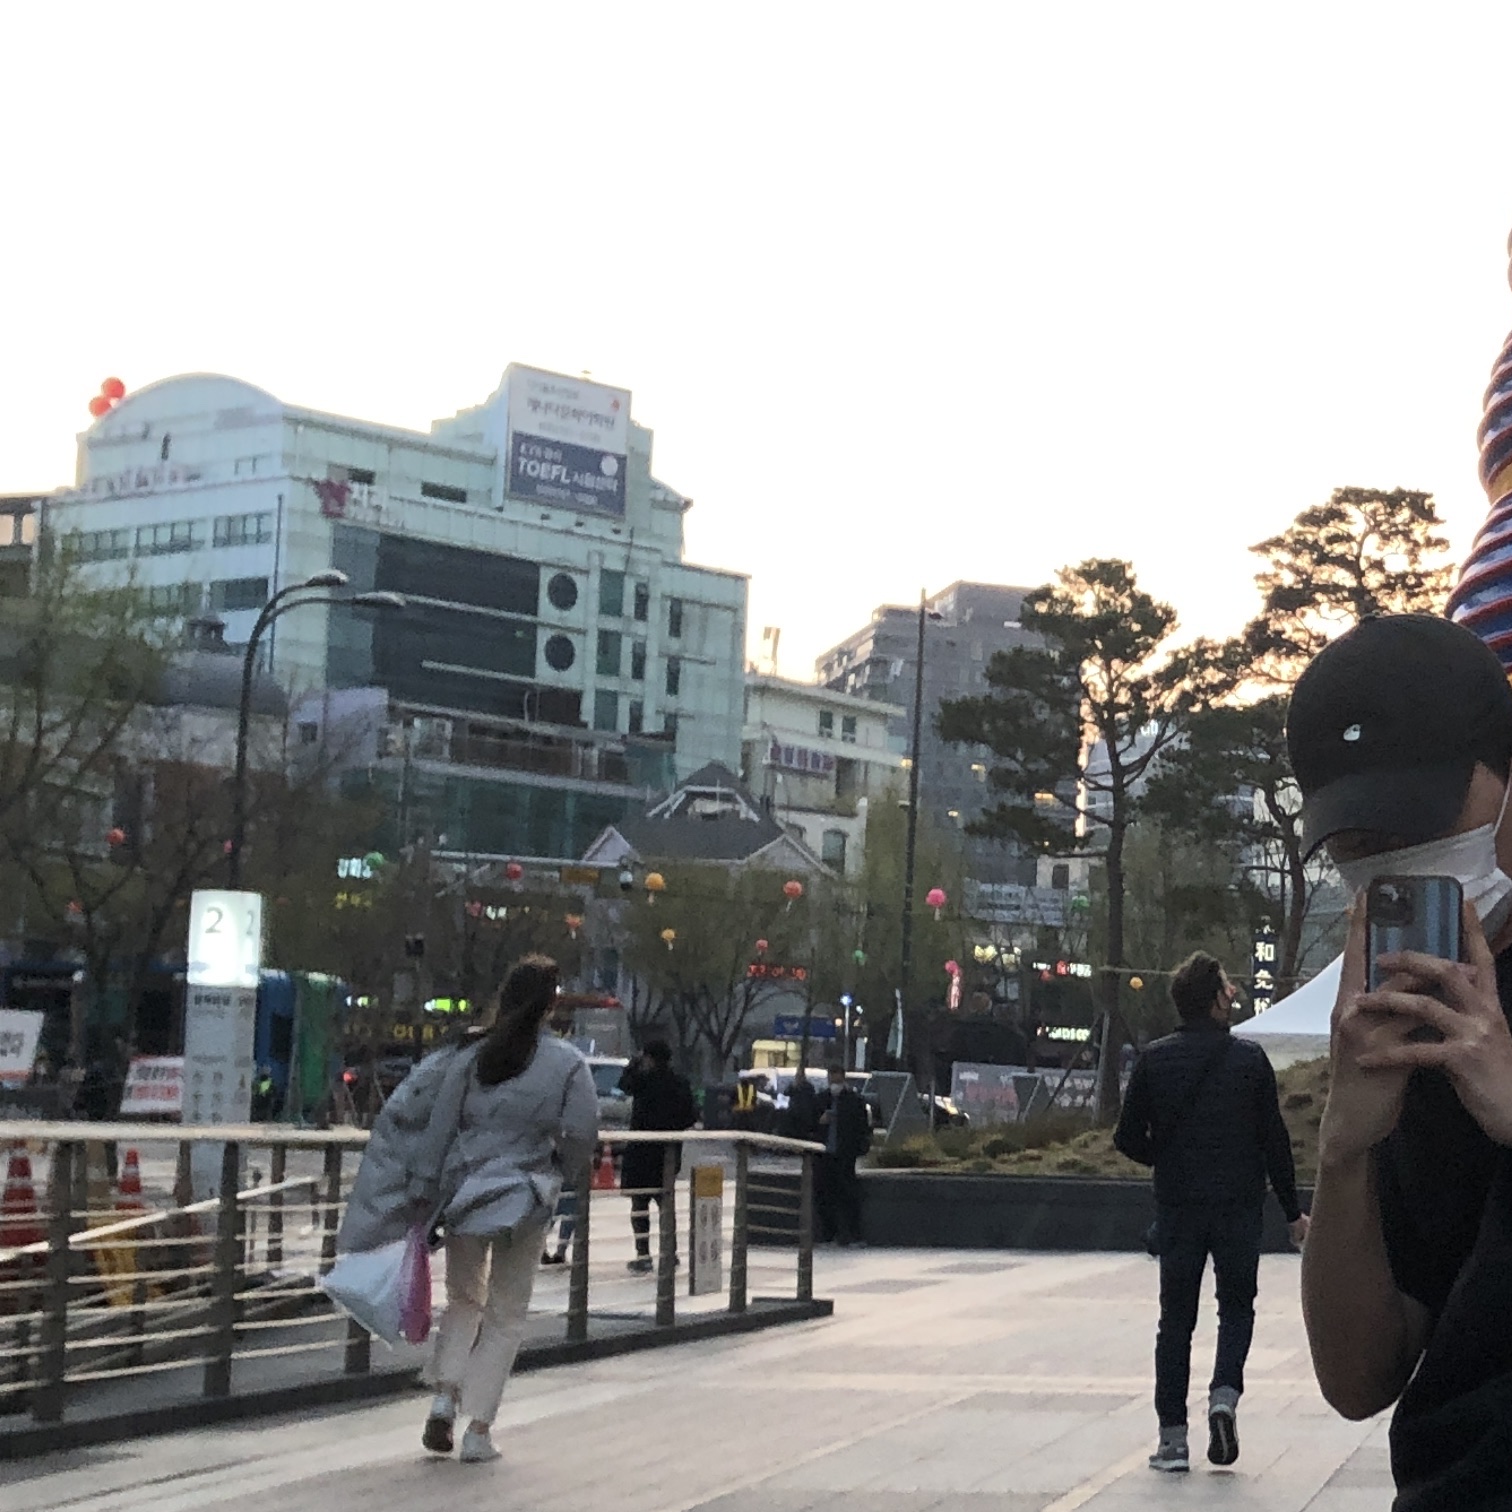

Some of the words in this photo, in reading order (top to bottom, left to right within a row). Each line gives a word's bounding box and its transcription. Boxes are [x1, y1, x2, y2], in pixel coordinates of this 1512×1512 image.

[519, 456, 570, 484] TOEFL
[205, 906, 224, 934] 2
[246, 909, 255, 936] 2
